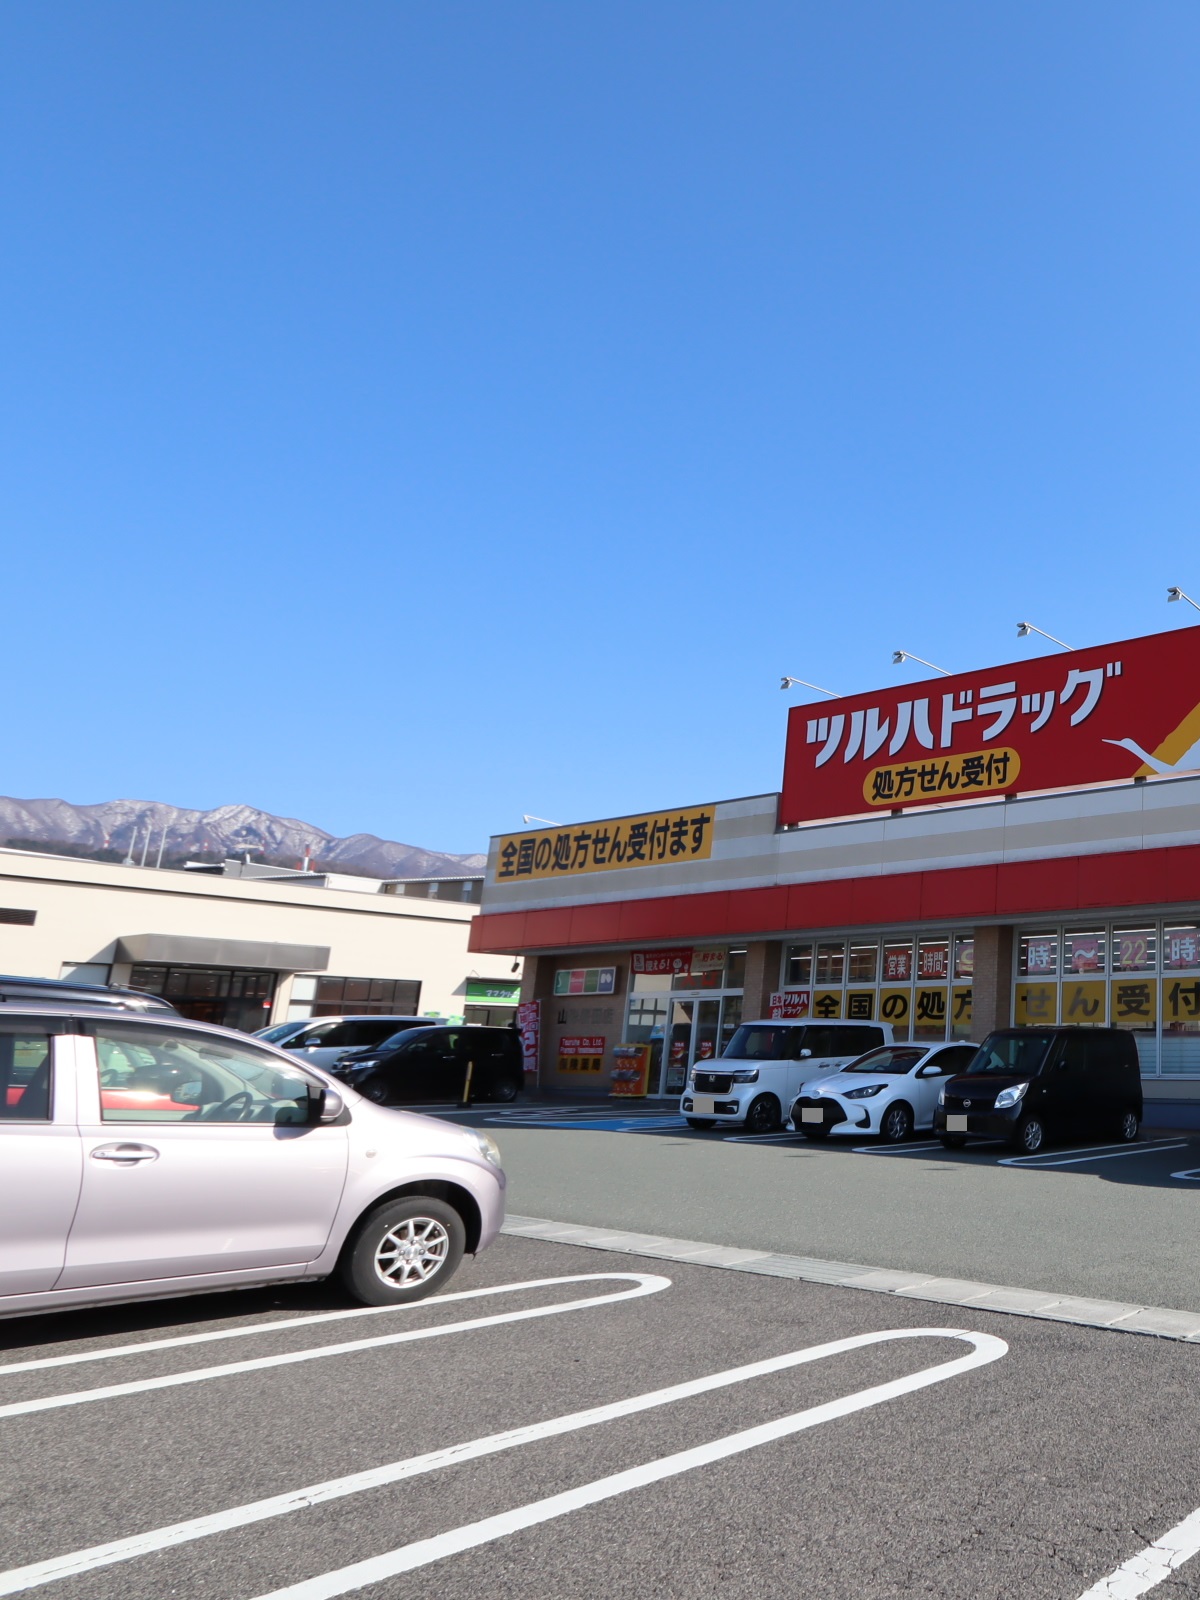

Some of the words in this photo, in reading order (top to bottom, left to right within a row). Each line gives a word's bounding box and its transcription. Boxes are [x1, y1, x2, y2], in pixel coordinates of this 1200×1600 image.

[806, 661, 1122, 768] ツルハドラッグ
[871, 751, 1010, 802] 処方せん受付
[498, 812, 711, 878] 全国の処方せん受付ます
[784, 993, 808, 1006] ツルハ
